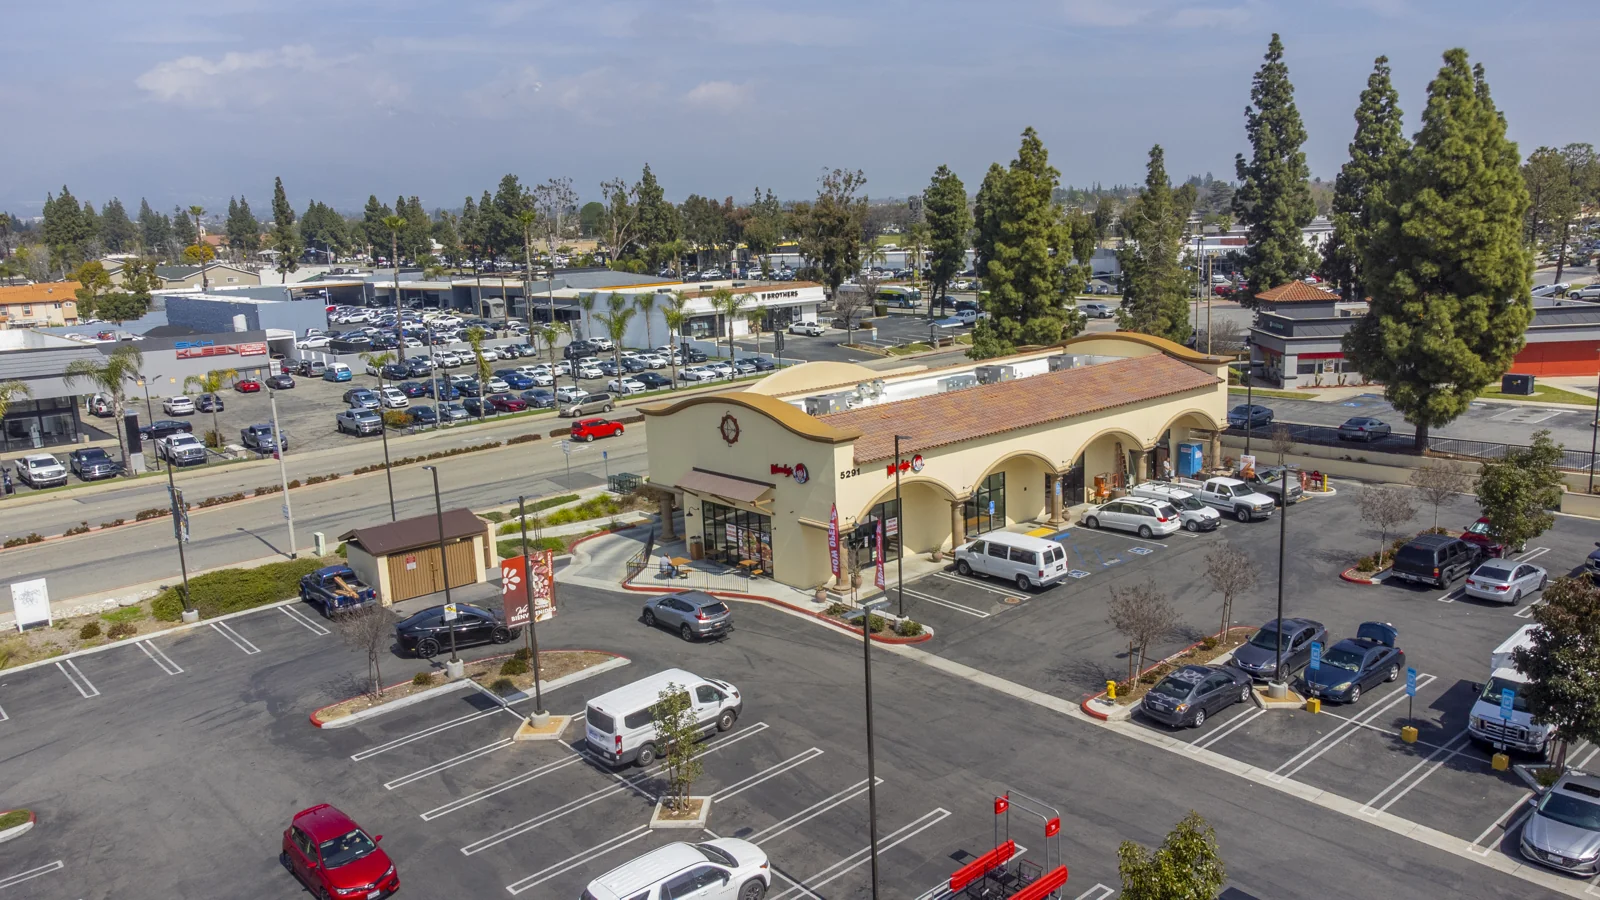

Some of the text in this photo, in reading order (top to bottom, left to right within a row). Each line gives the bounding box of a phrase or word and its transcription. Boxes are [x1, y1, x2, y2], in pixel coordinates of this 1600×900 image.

[767, 291, 798, 299] BROTHERS
[176, 345, 239, 359] KLEEN
[840, 468, 861, 480] 5291
